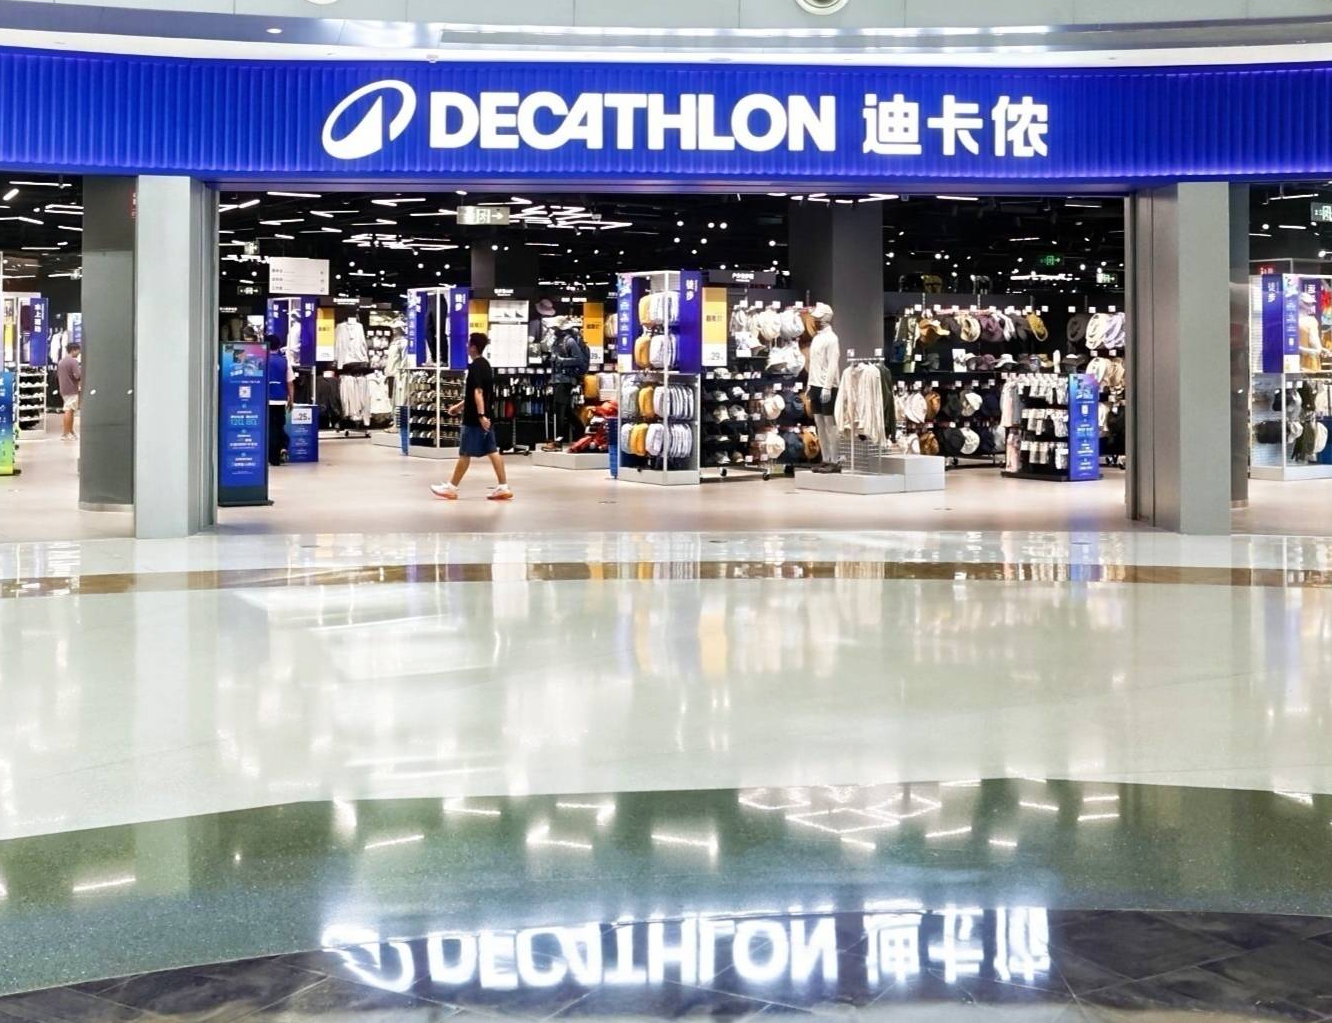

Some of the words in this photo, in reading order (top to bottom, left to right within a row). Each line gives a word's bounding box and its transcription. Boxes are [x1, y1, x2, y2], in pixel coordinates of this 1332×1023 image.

[430, 90, 836, 153] DECATHLON
[862, 92, 1049, 157] 迪卡侬
